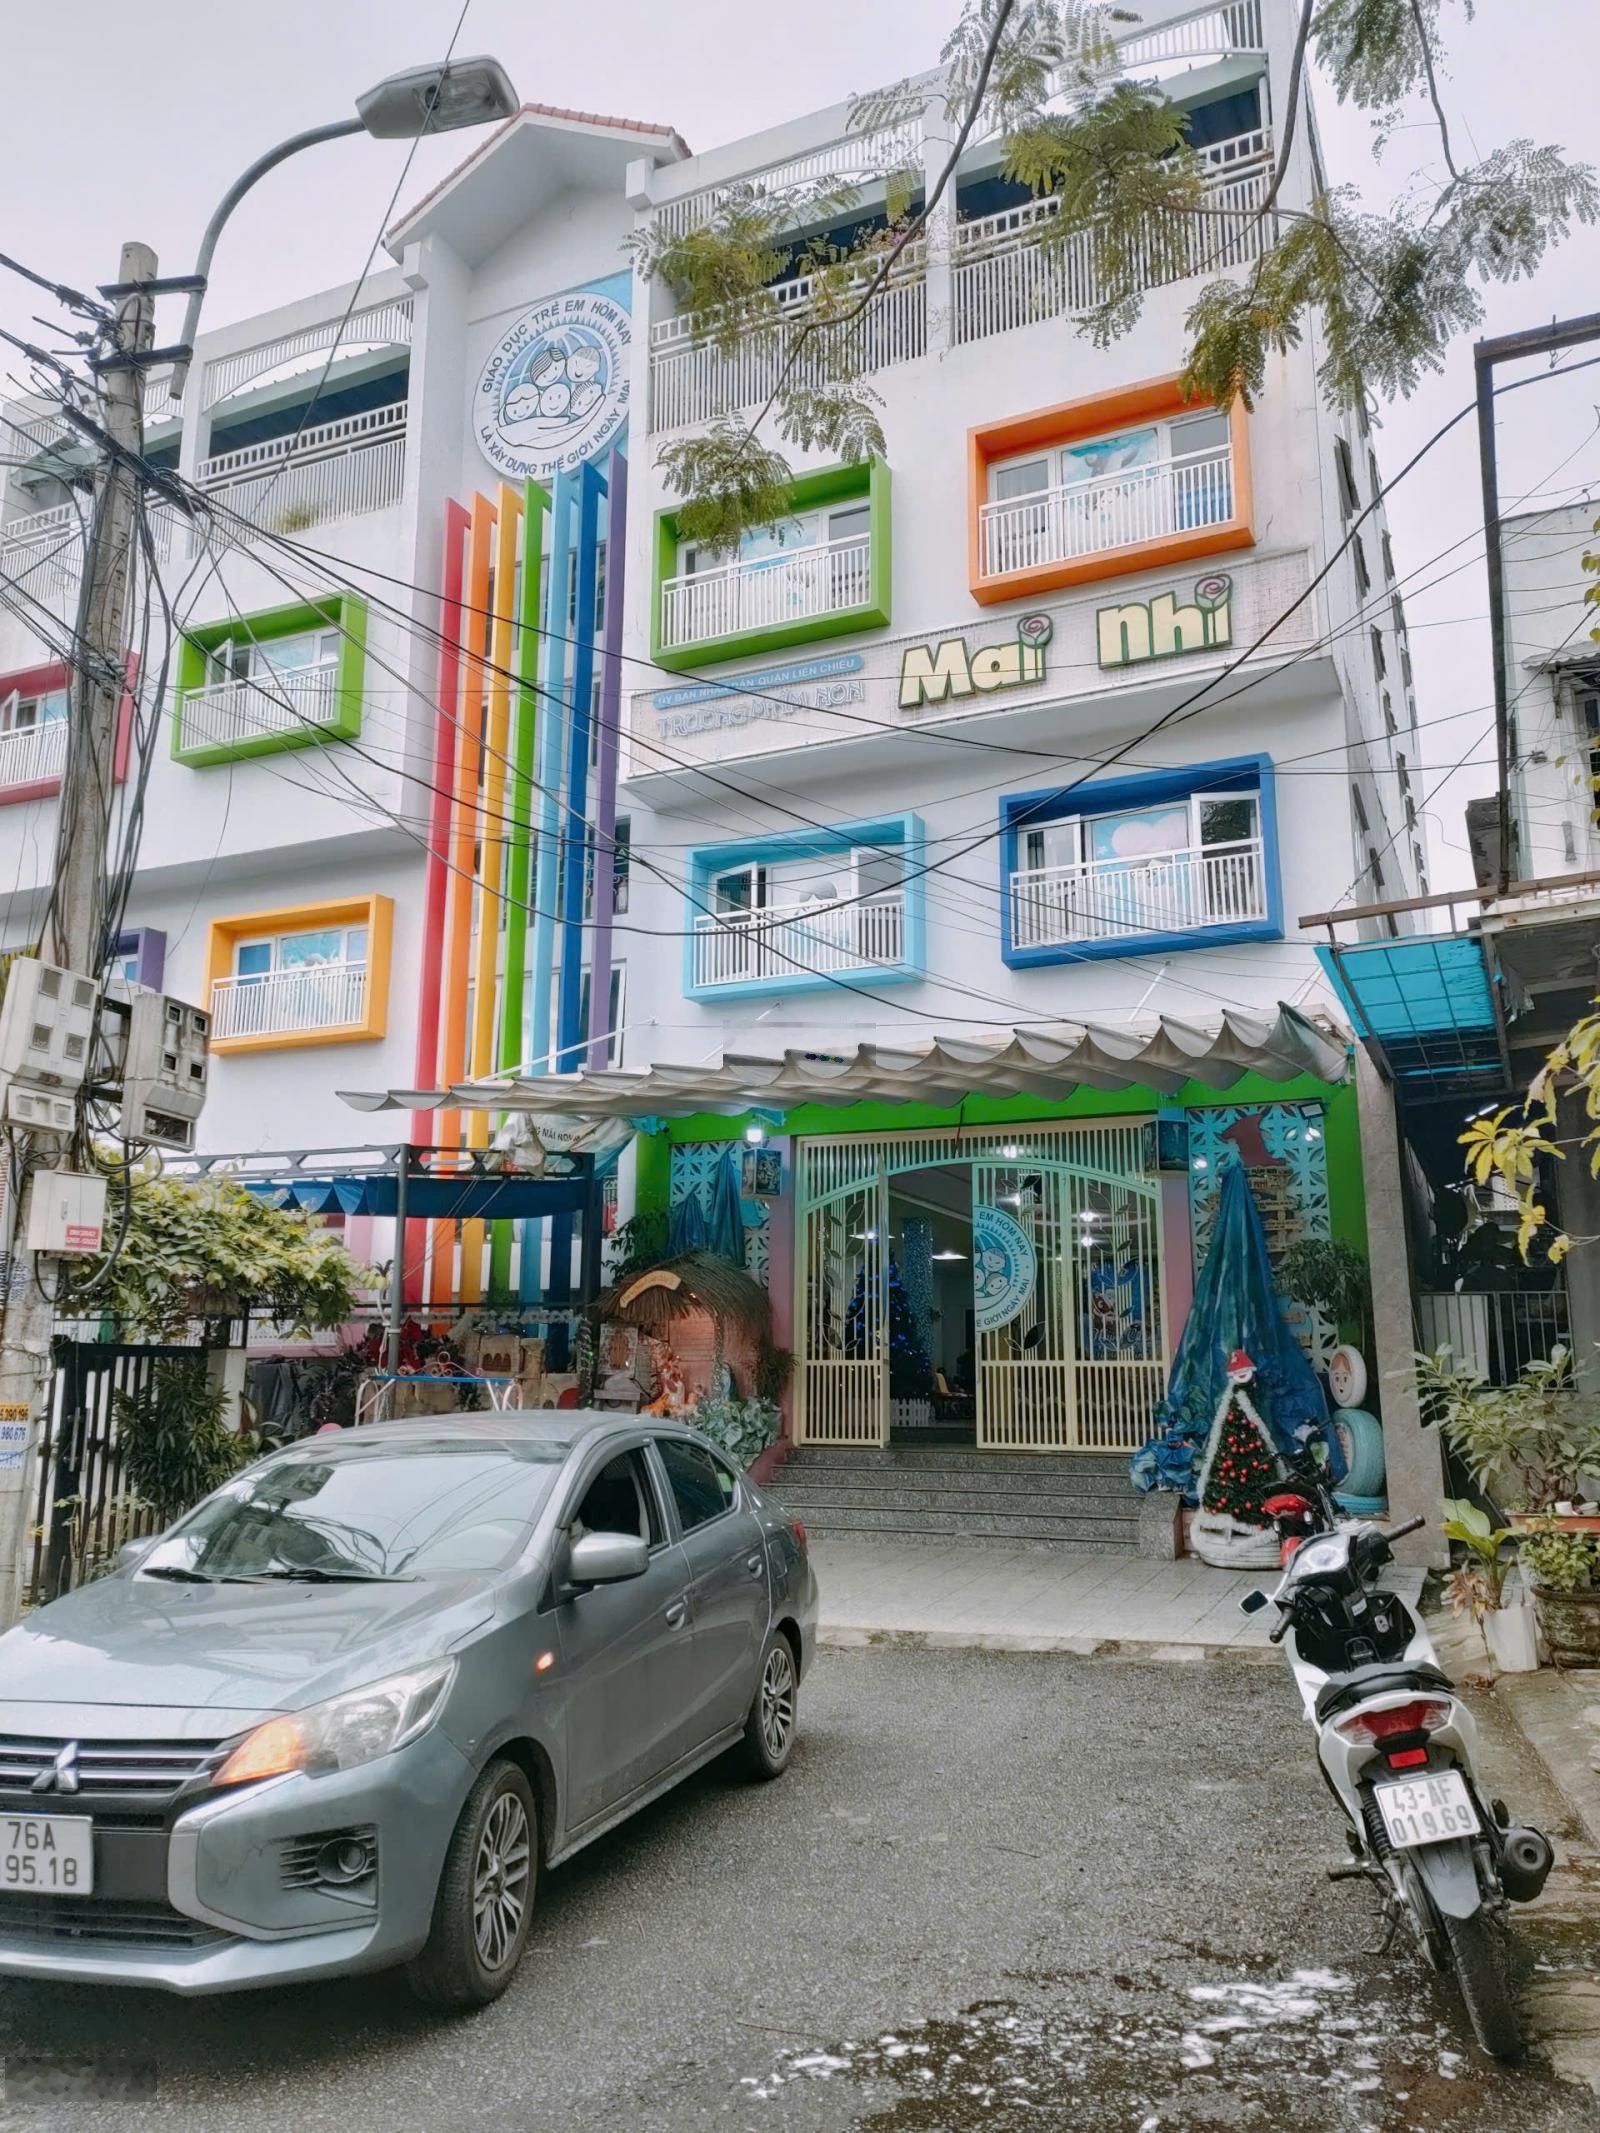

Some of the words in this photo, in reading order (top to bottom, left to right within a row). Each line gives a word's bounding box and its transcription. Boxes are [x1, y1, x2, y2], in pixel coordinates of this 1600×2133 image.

[502, 324, 528, 352] DỤC
[565, 300, 585, 312] EM
[615, 319, 631, 345] NAY
[617, 380, 630, 404] MAI
[980, 1211, 994, 1221] EM
[1016, 1235, 1028, 1256] NAY
[1019, 1279, 1029, 1295] MAI
[8, 1821, 56, 1851] 76A
[1392, 1804, 1473, 1842] 019.69
